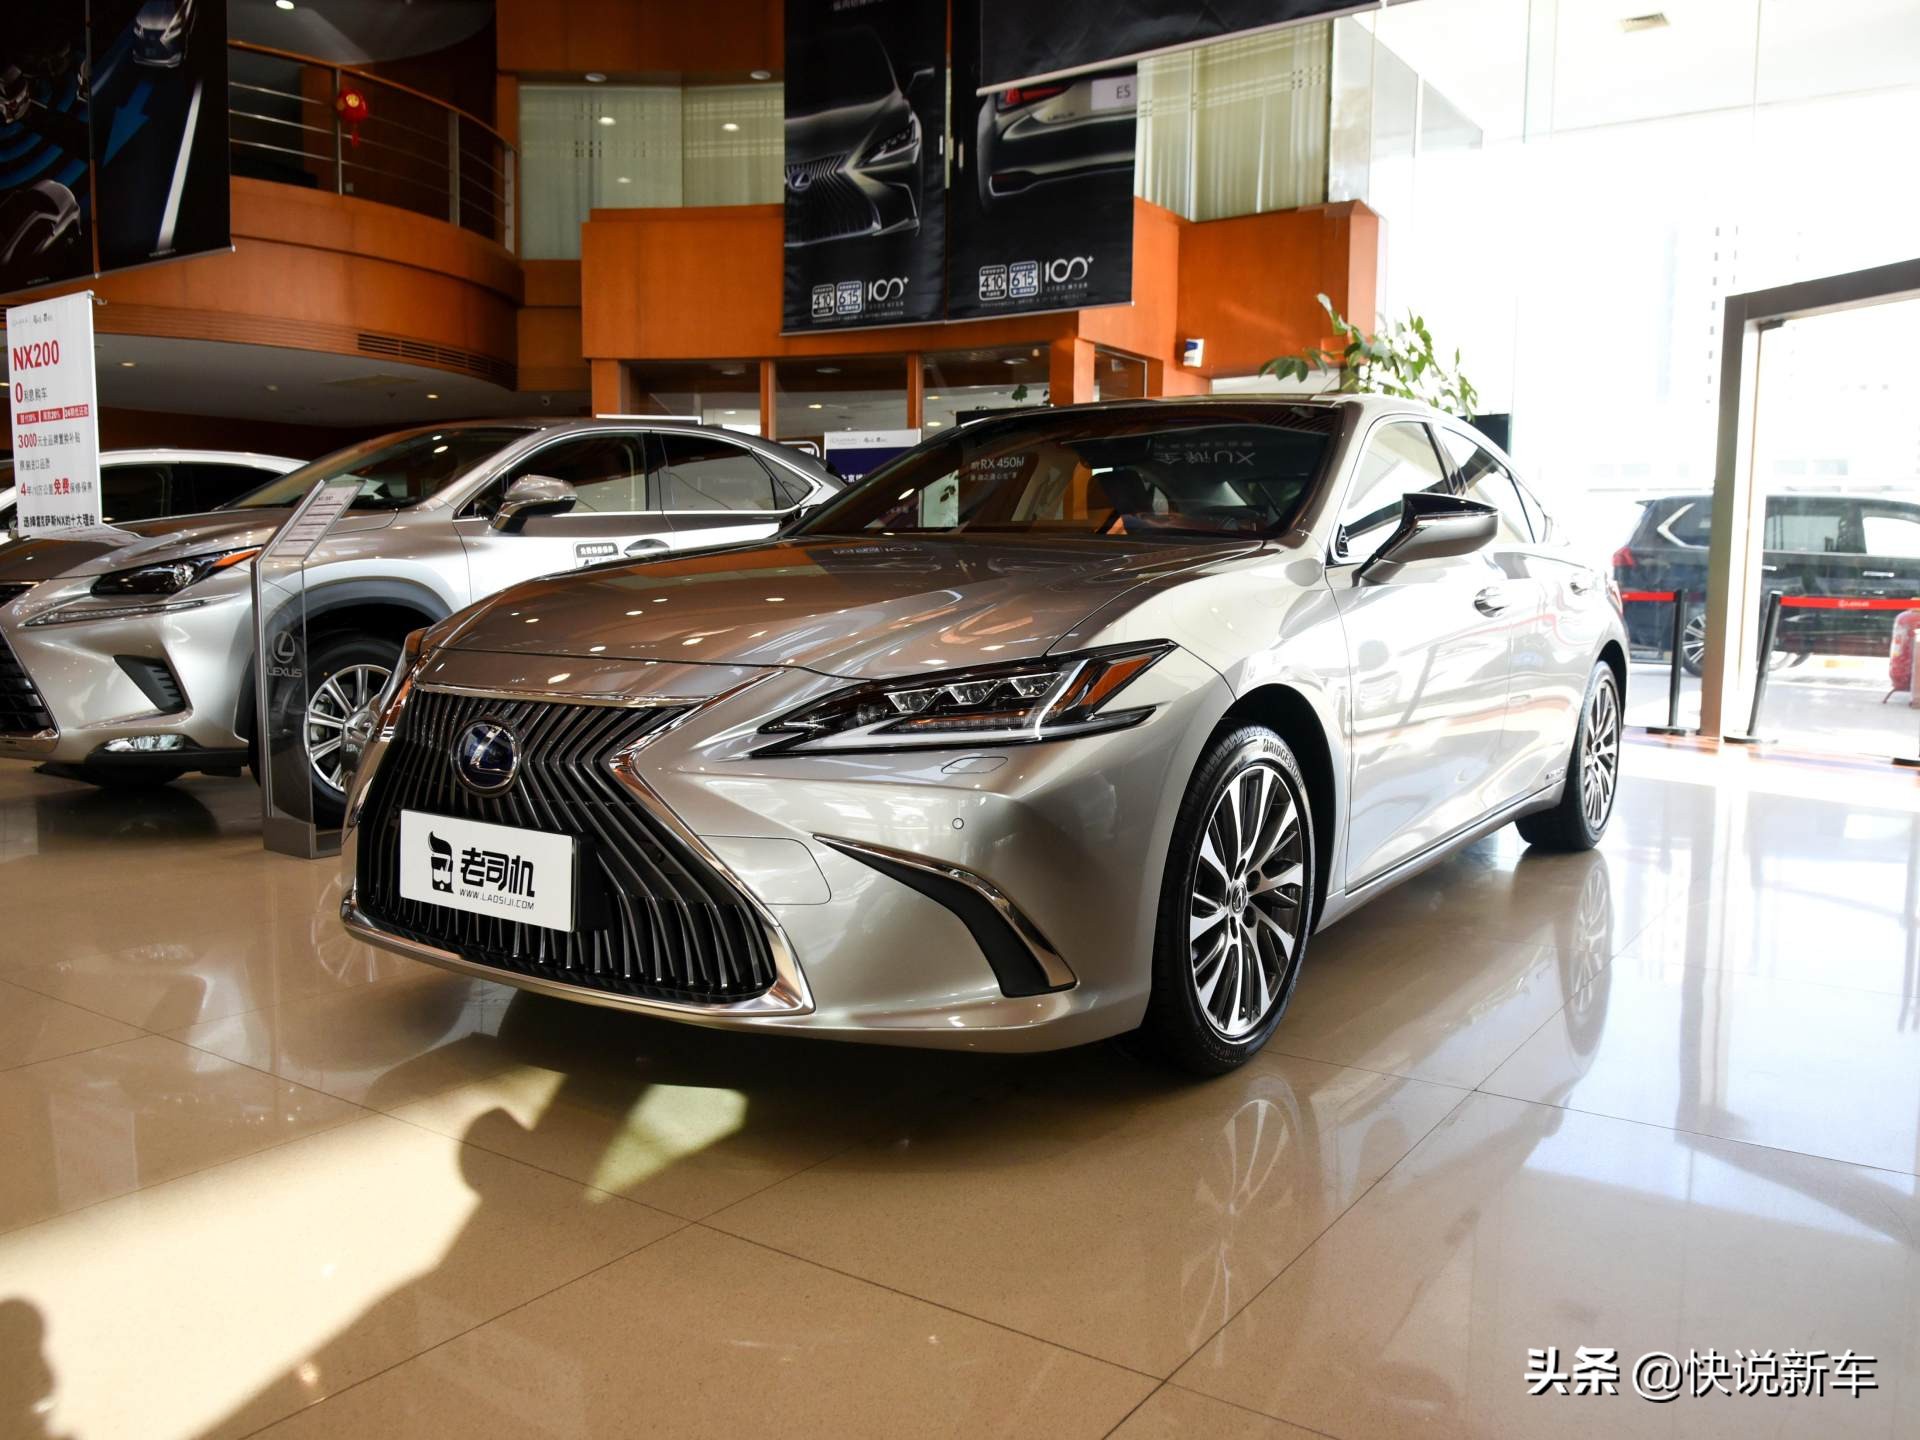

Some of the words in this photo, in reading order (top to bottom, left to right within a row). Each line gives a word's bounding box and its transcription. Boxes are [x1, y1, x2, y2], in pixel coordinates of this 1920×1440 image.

[1116, 84, 1131, 99] ES
[13, 340, 60, 371] NX200
[266, 666, 302, 678] LEXUS
[1262, 738, 1305, 792] BRIDGESTONE
[460, 847, 535, 898] 老司机
[459, 888, 535, 911] WWW.LAOSIJI.COM
